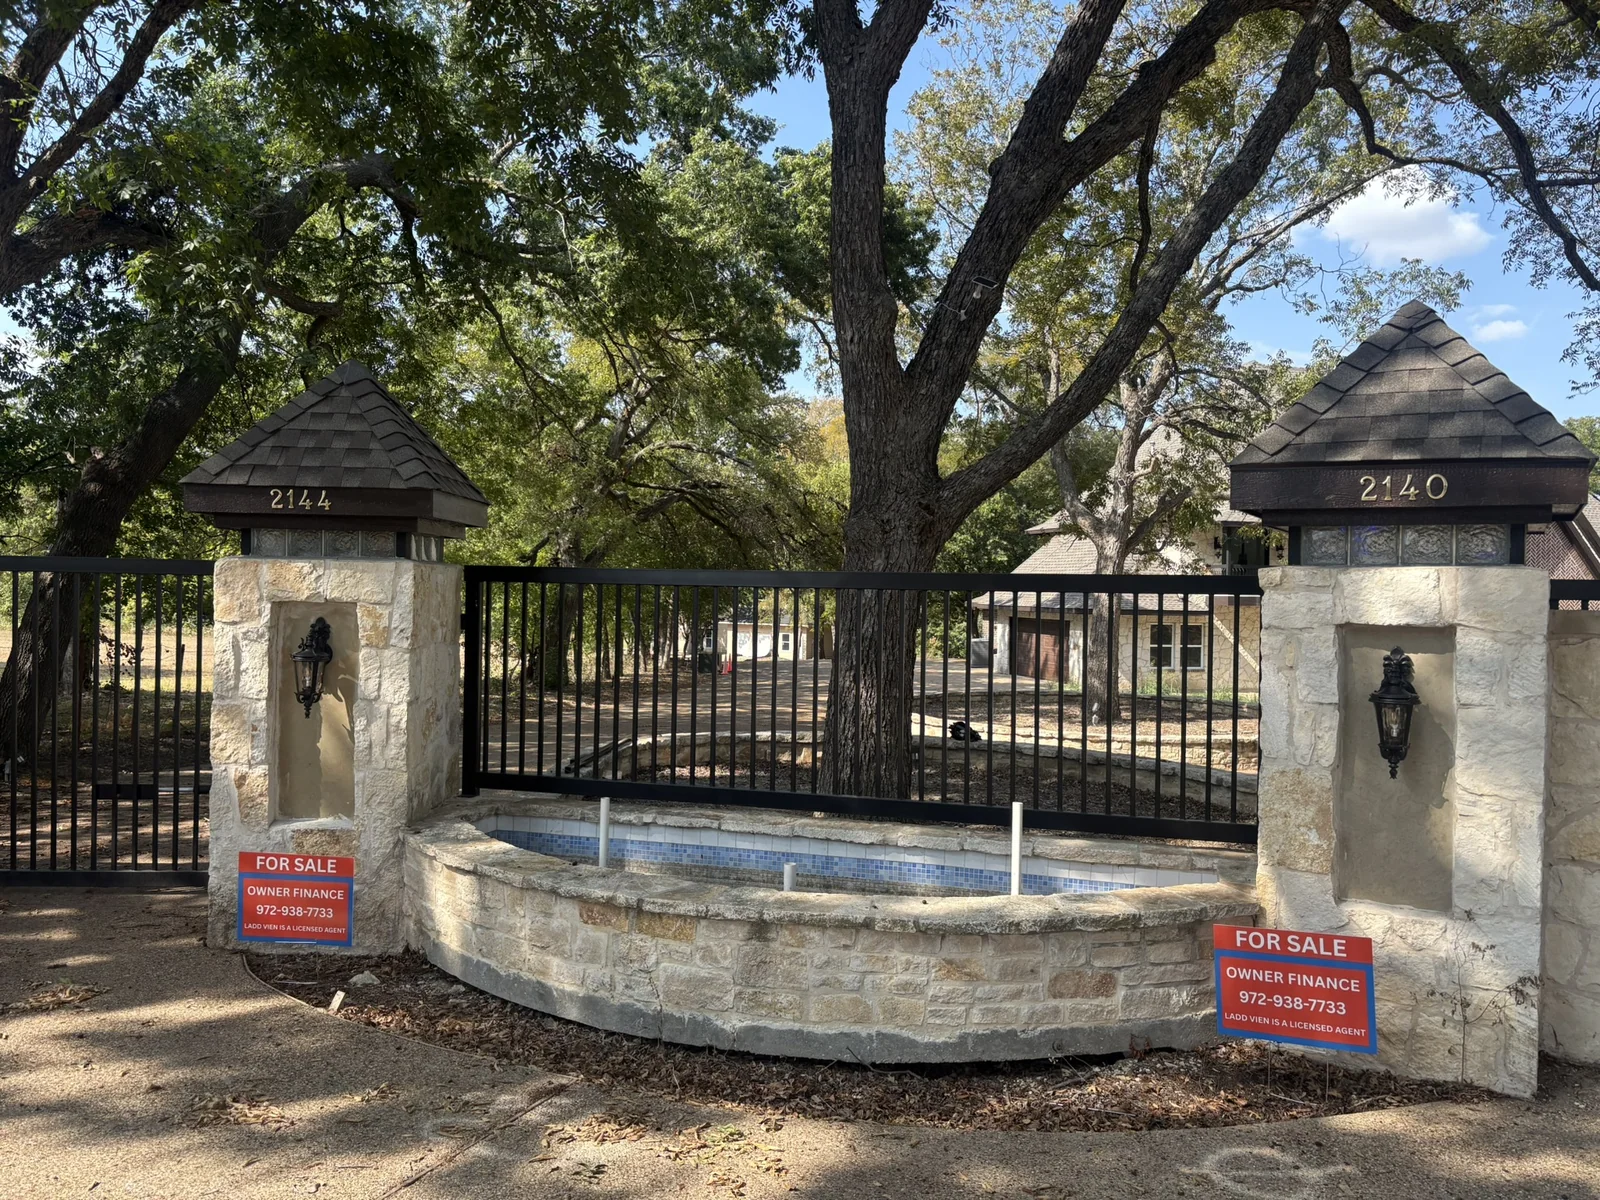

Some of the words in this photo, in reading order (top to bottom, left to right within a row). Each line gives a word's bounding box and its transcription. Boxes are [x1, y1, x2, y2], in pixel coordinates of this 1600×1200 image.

[1360, 474, 1448, 500] 2140
[270, 489, 331, 510] 2144
[256, 856, 289, 871] FOR
[294, 858, 337, 873] SALE
[247, 886, 290, 897] OWNER
[294, 888, 344, 900] FINANCE
[256, 905, 333, 918] 972-938-7733
[1236, 930, 1281, 950] FOR
[1287, 935, 1347, 957] SALE
[1226, 967, 1283, 984] OWNER
[1288, 973, 1360, 992] FINANCE
[1239, 991, 1346, 1015] 972-938-7733
[1225, 1012, 1248, 1021] LADD
[1250, 1015, 1270, 1024] VIEN
[1290, 1021, 1333, 1033] LICENSED
[1335, 1026, 1366, 1037] AGENT
